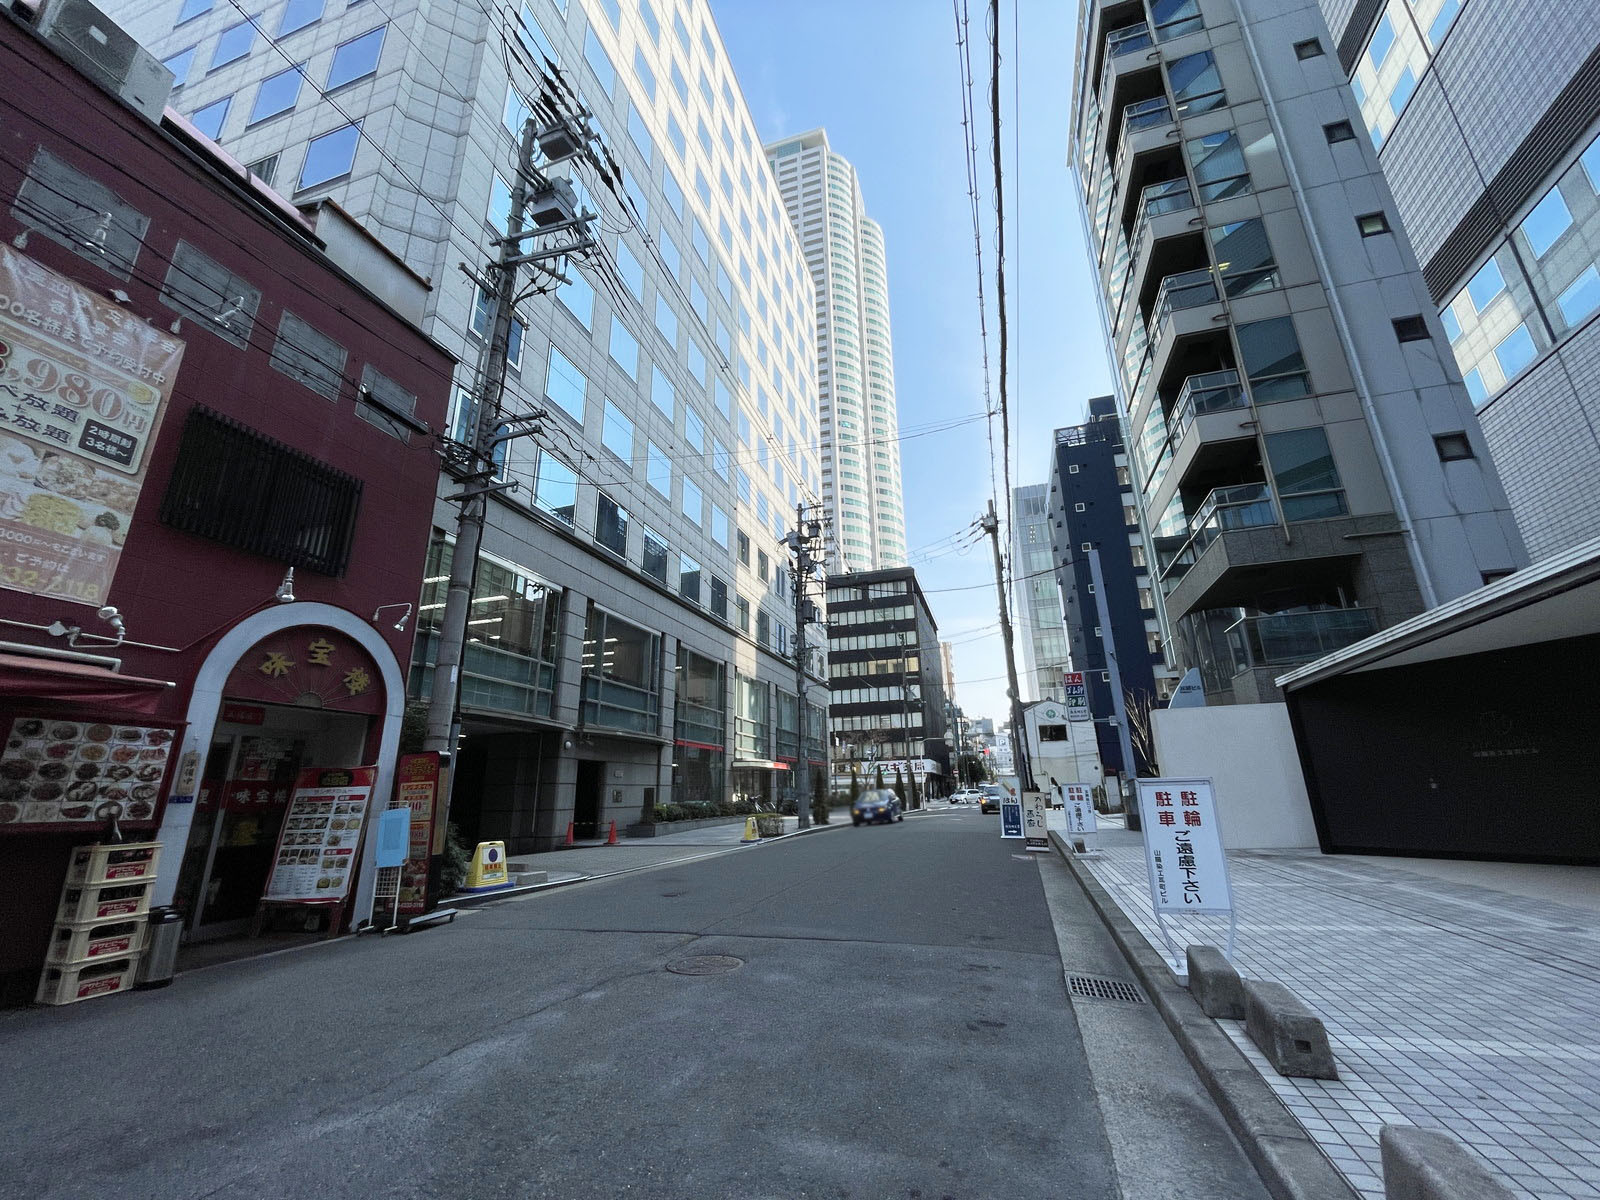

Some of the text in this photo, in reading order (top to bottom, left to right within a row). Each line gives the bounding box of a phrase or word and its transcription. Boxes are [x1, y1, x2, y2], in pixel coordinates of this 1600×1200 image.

[1155, 791, 1176, 827] 駐車
[1180, 790, 1202, 827] 駐輪
[1174, 829, 1202, 904] ご遠慮下さい
